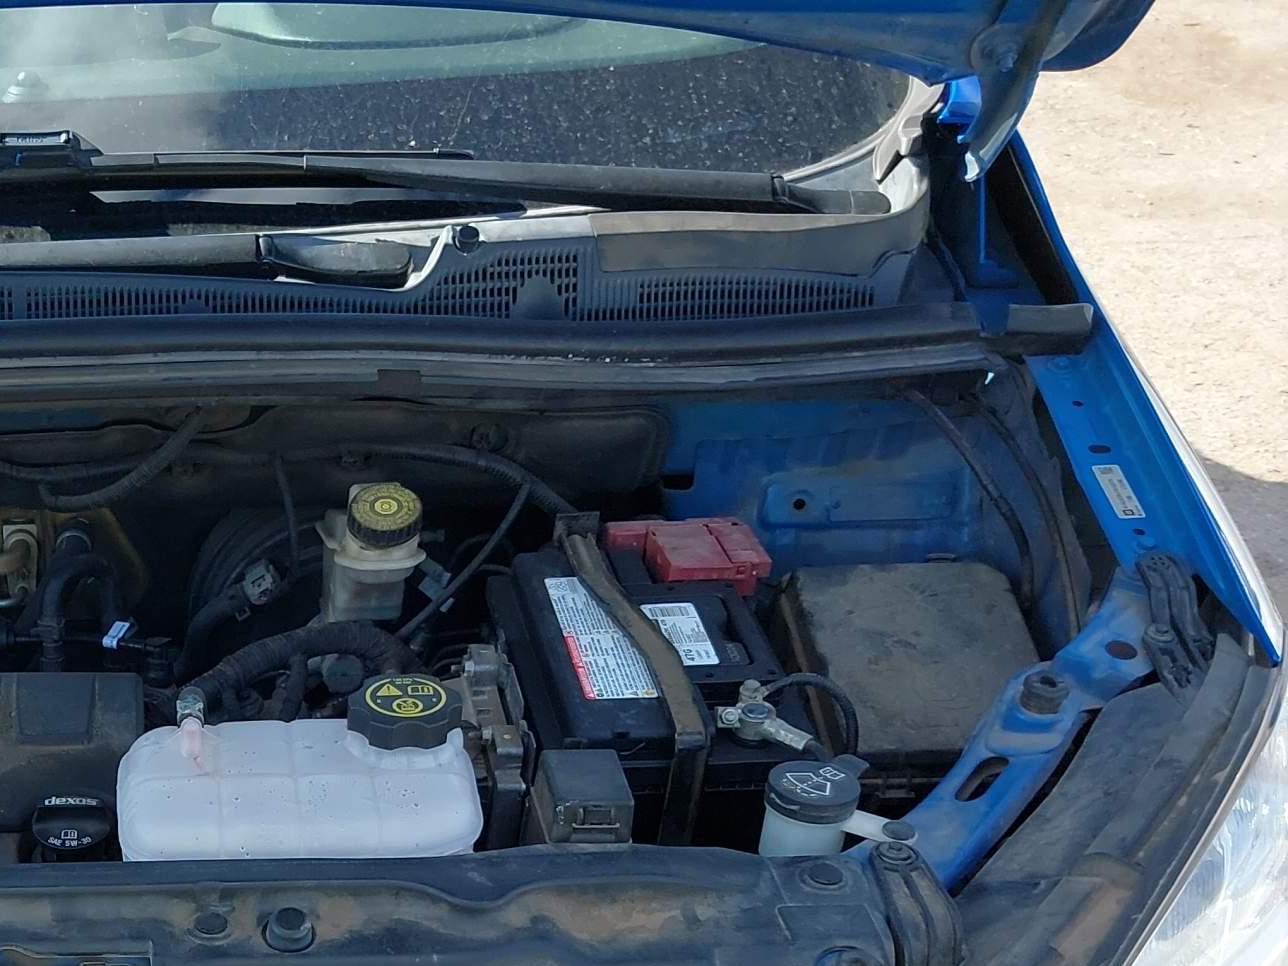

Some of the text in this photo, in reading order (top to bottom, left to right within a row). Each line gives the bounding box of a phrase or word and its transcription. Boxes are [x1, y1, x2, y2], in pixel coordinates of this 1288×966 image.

[44, 796, 98, 806] dexos
[47, 836, 92, 847] SAE 5W-30
